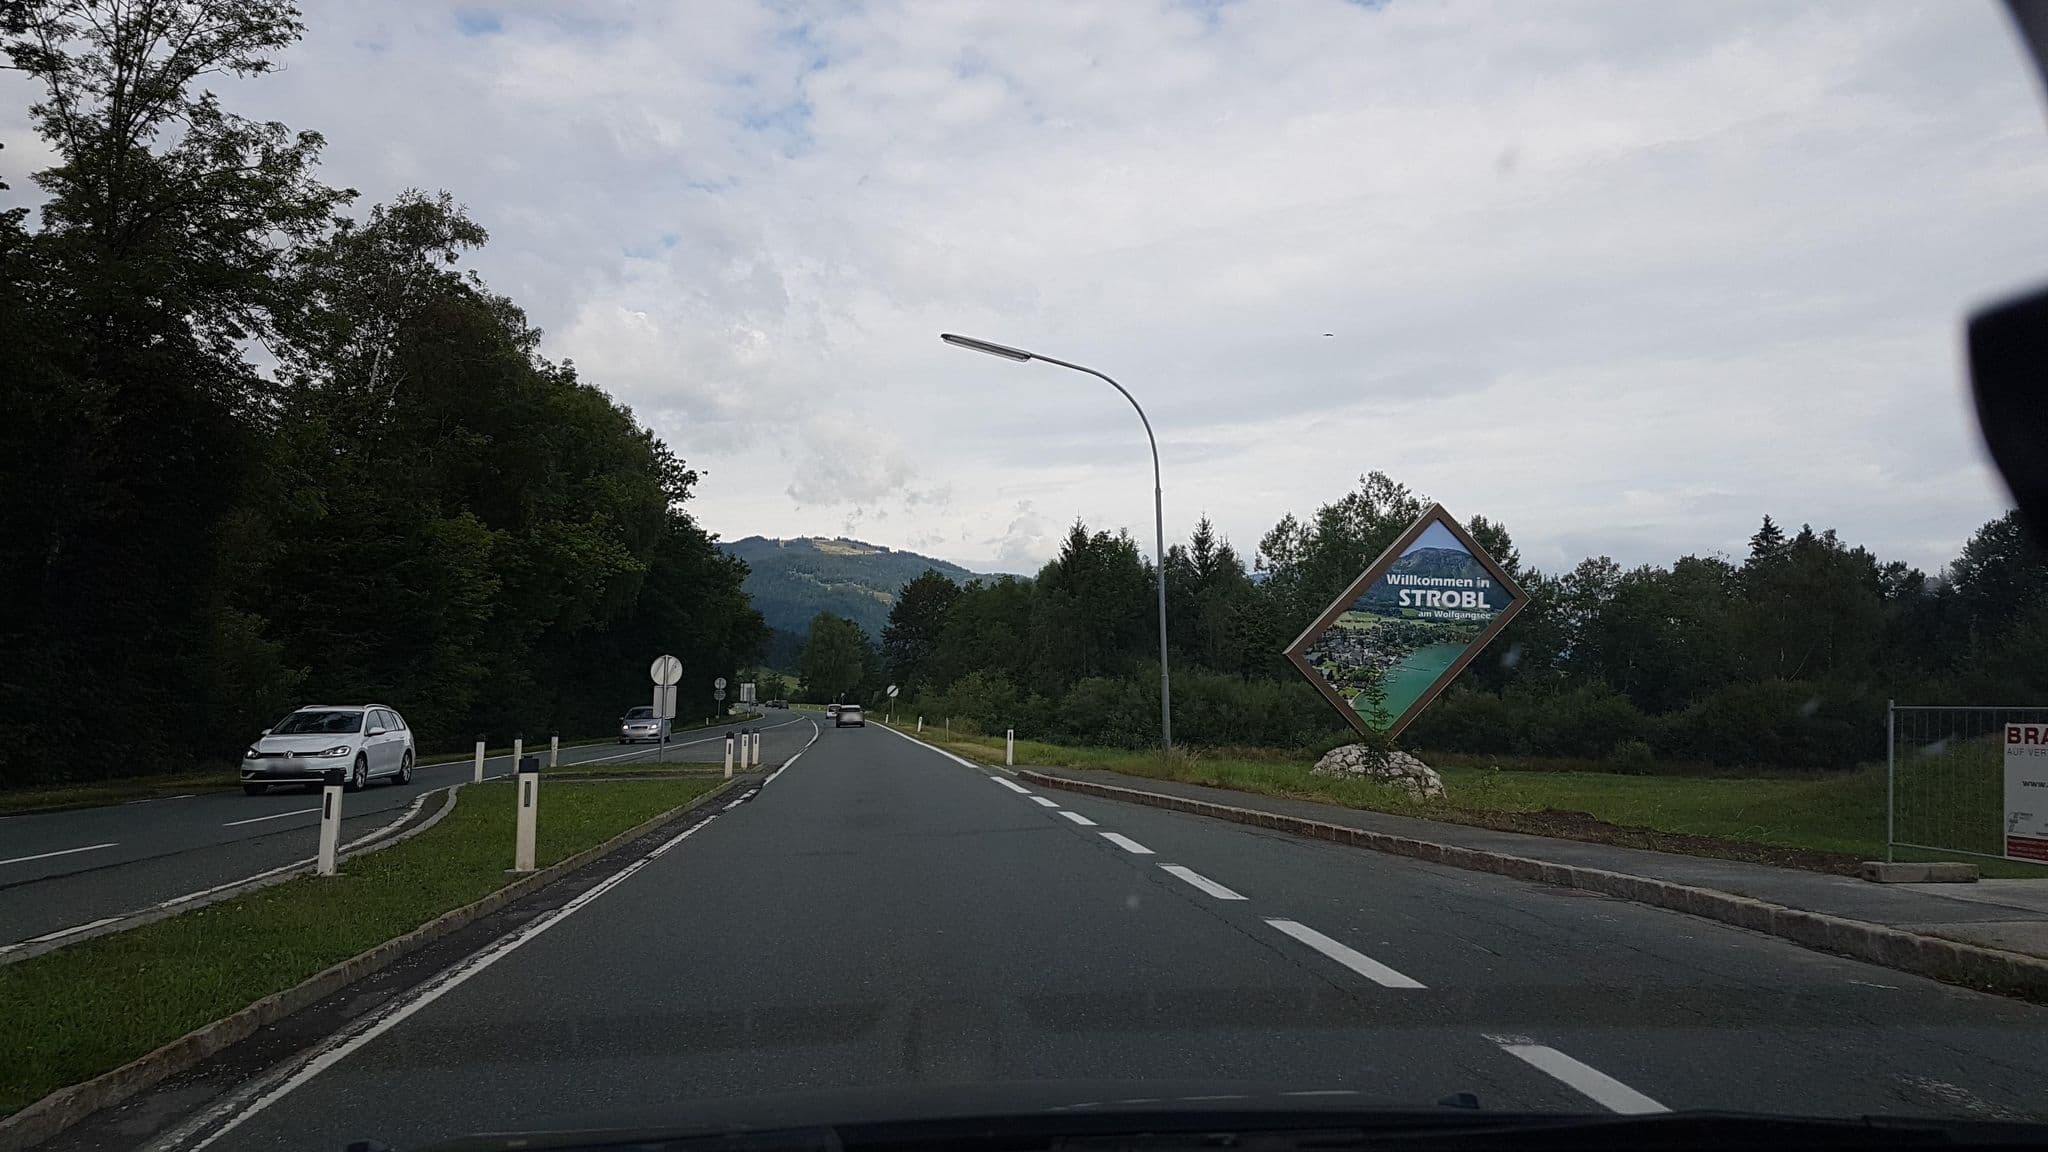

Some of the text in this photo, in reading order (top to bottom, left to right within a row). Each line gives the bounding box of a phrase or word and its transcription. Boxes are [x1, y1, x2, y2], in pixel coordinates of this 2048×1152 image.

[1386, 574, 1490, 588] Willkommen in
[1398, 589, 1491, 608] STROBL
[1434, 611, 1491, 620] Wolfgangsee
[2007, 747, 2024, 756] AUF
